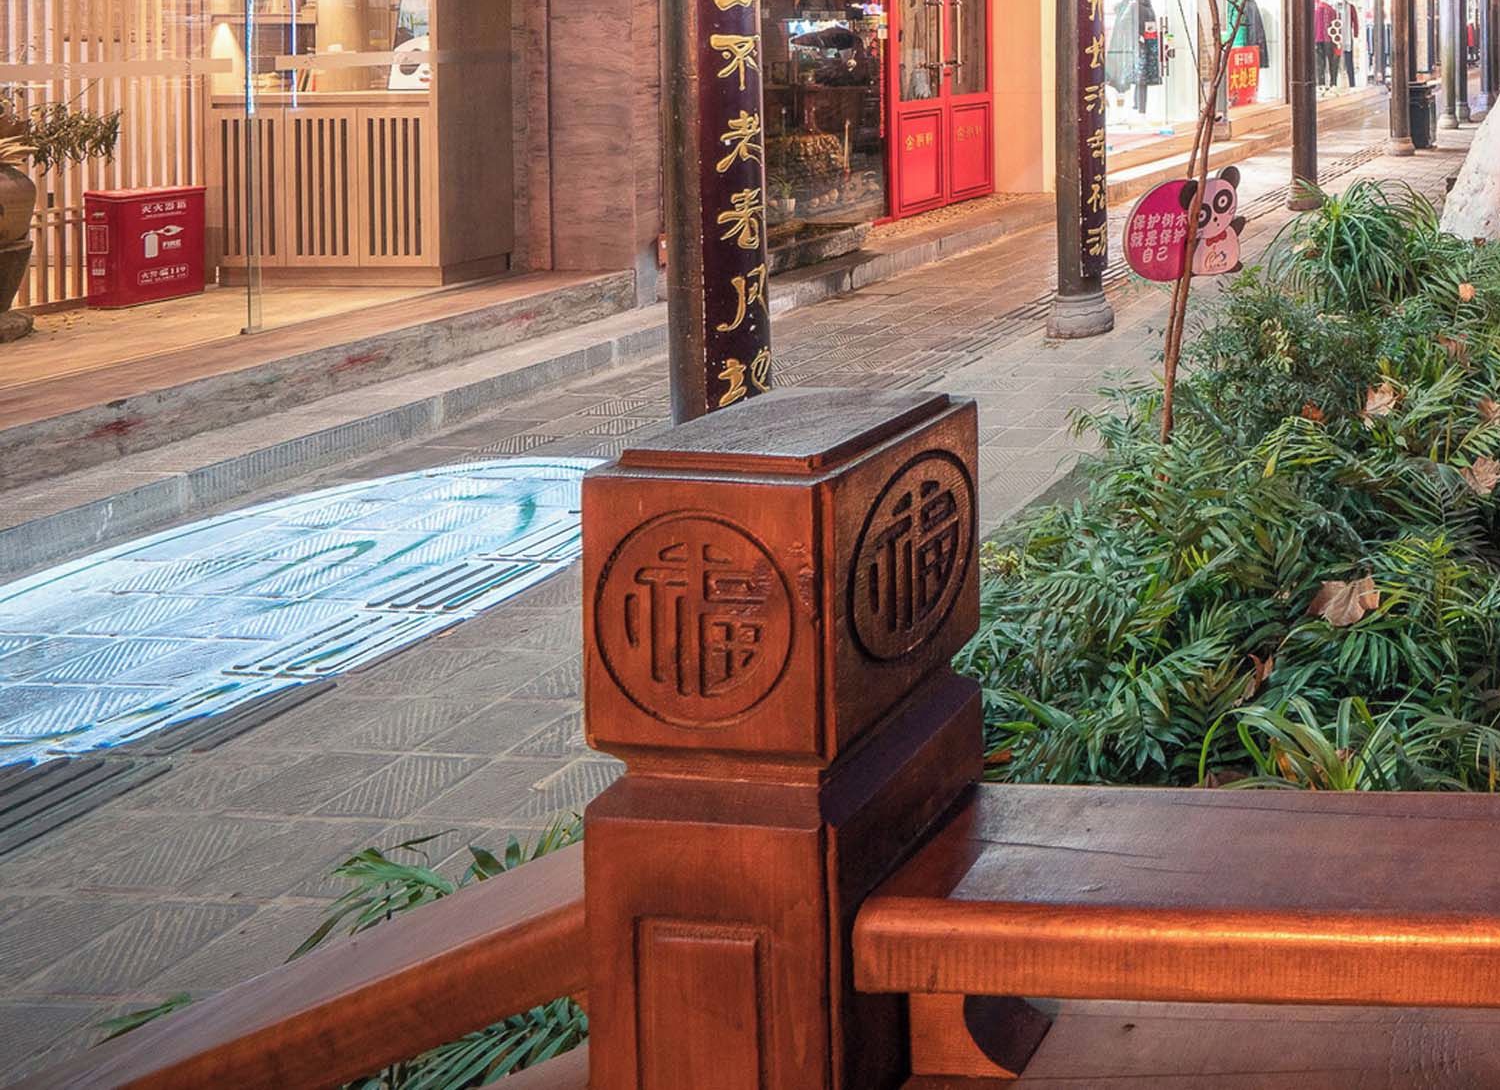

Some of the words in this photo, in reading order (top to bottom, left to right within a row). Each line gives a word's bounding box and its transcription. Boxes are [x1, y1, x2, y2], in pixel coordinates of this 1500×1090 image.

[1133, 212, 1188, 230] 保护树木
[1130, 228, 1186, 248] 就是保护
[1142, 246, 1168, 263] 自己
[623, 541, 769, 698] 福
